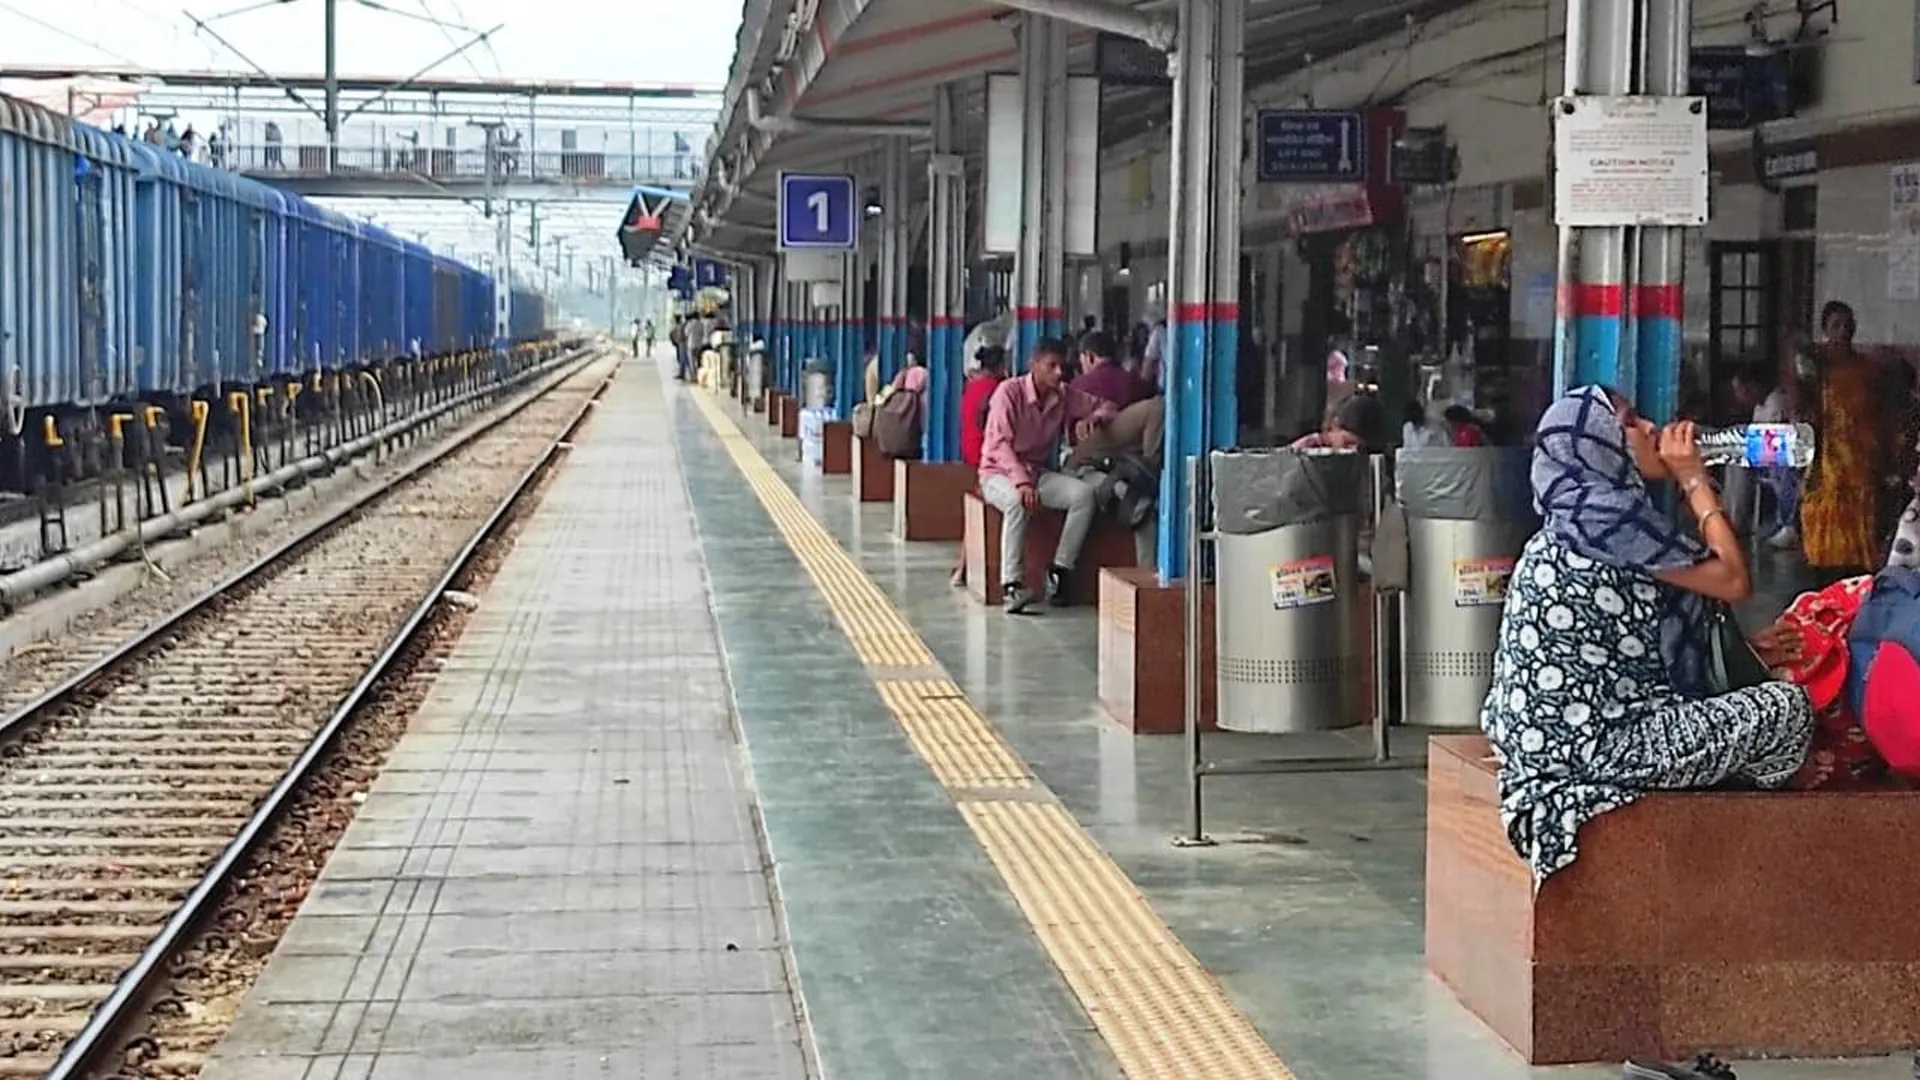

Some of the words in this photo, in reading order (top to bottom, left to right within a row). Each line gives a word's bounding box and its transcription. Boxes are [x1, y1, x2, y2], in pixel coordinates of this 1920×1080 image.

[1589, 158, 1636, 167] CAUTION
[1639, 158, 1676, 167] NOTICE
[807, 192, 828, 232] 1
[706, 264, 715, 282] 1
